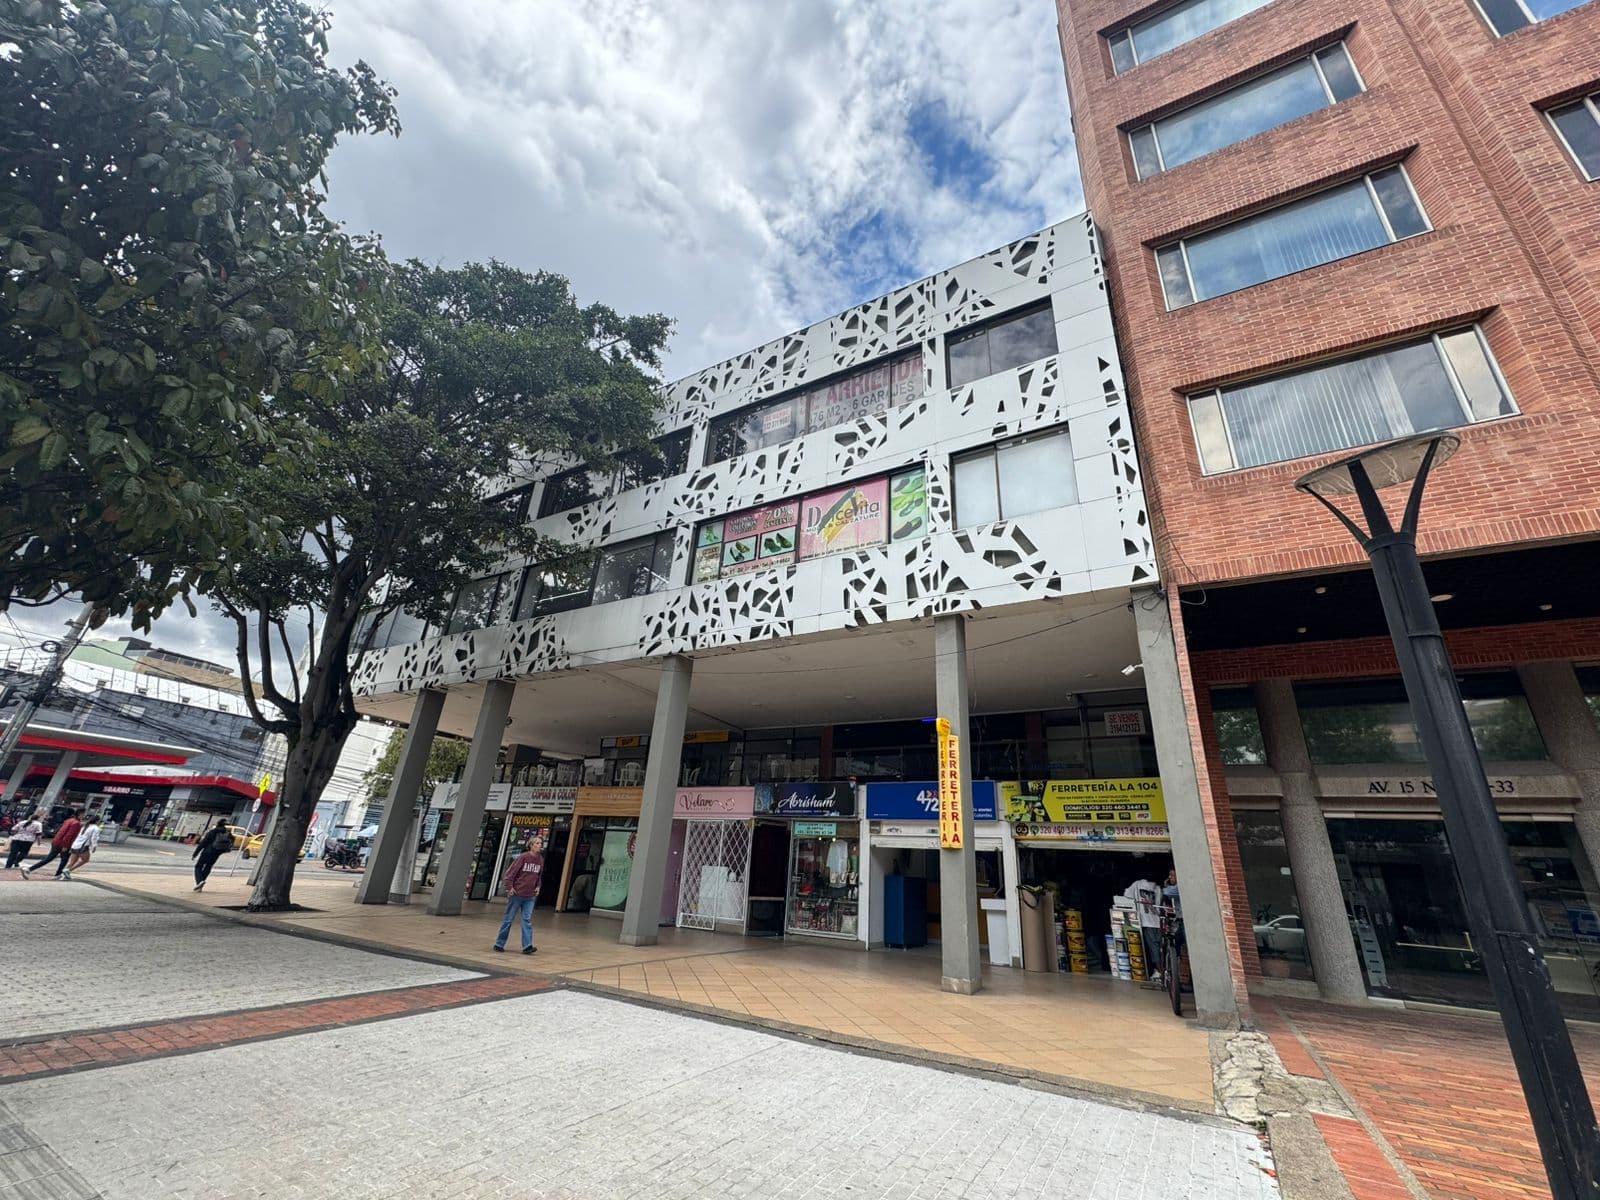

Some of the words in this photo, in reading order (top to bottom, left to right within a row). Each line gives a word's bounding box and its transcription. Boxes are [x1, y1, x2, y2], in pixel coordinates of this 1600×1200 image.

[948, 740, 960, 843] FERRETERIA
[1051, 781, 1116, 793] FERRETERÍA
[1120, 783, 1135, 792] LA
[1138, 782, 1158, 791] 104
[1368, 782, 1390, 794] AV.
[1401, 781, 1414, 794] 15
[778, 787, 836, 809] Abrisham
[513, 816, 552, 826] FOTOCOPIAS
